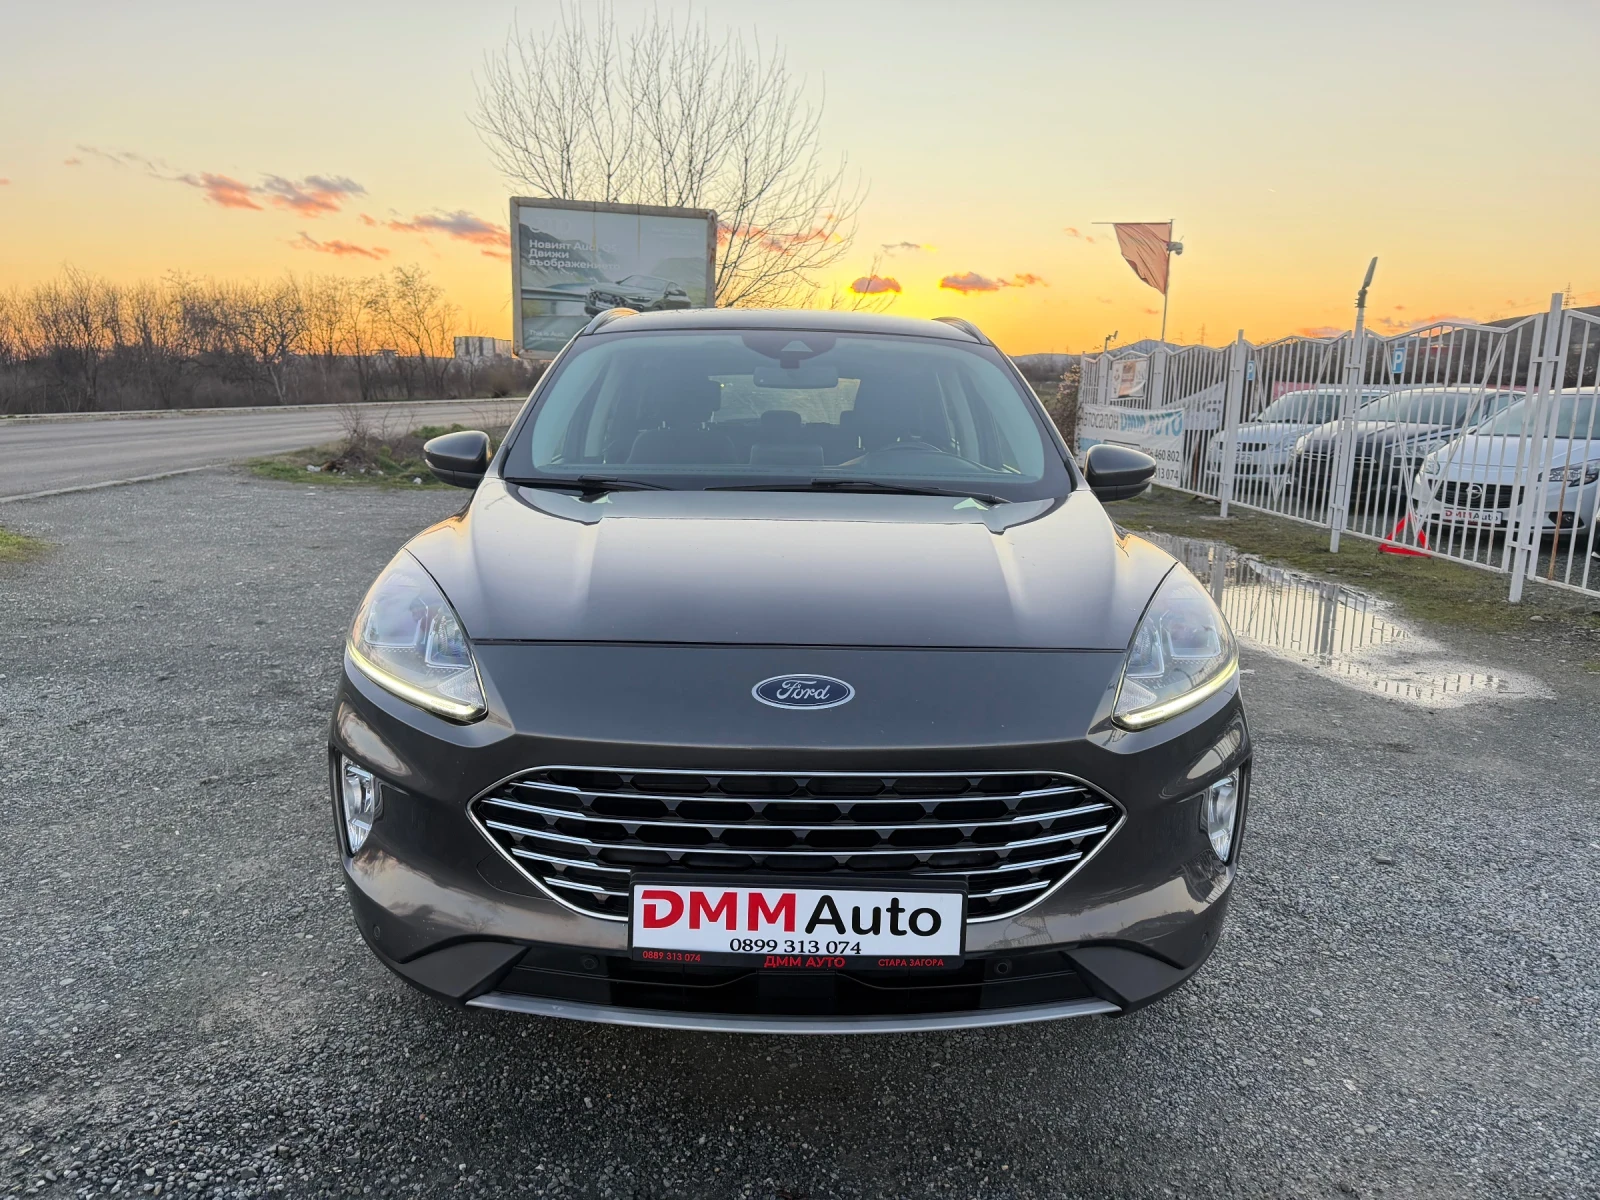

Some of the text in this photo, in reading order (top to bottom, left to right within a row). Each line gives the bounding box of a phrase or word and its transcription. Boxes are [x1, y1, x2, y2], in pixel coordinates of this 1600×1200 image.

[529, 239, 571, 250] Новият
[528, 248, 570, 259] Движи
[1393, 350, 1403, 371] P
[776, 679, 831, 700] Ford
[641, 889, 942, 937] DMM Auto
[729, 938, 862, 955] 0899 313 074
[642, 950, 701, 962] 0889 313 074
[764, 955, 846, 968] ДММ АУТО
[878, 958, 944, 967] СТАРА ЗАГОРА
